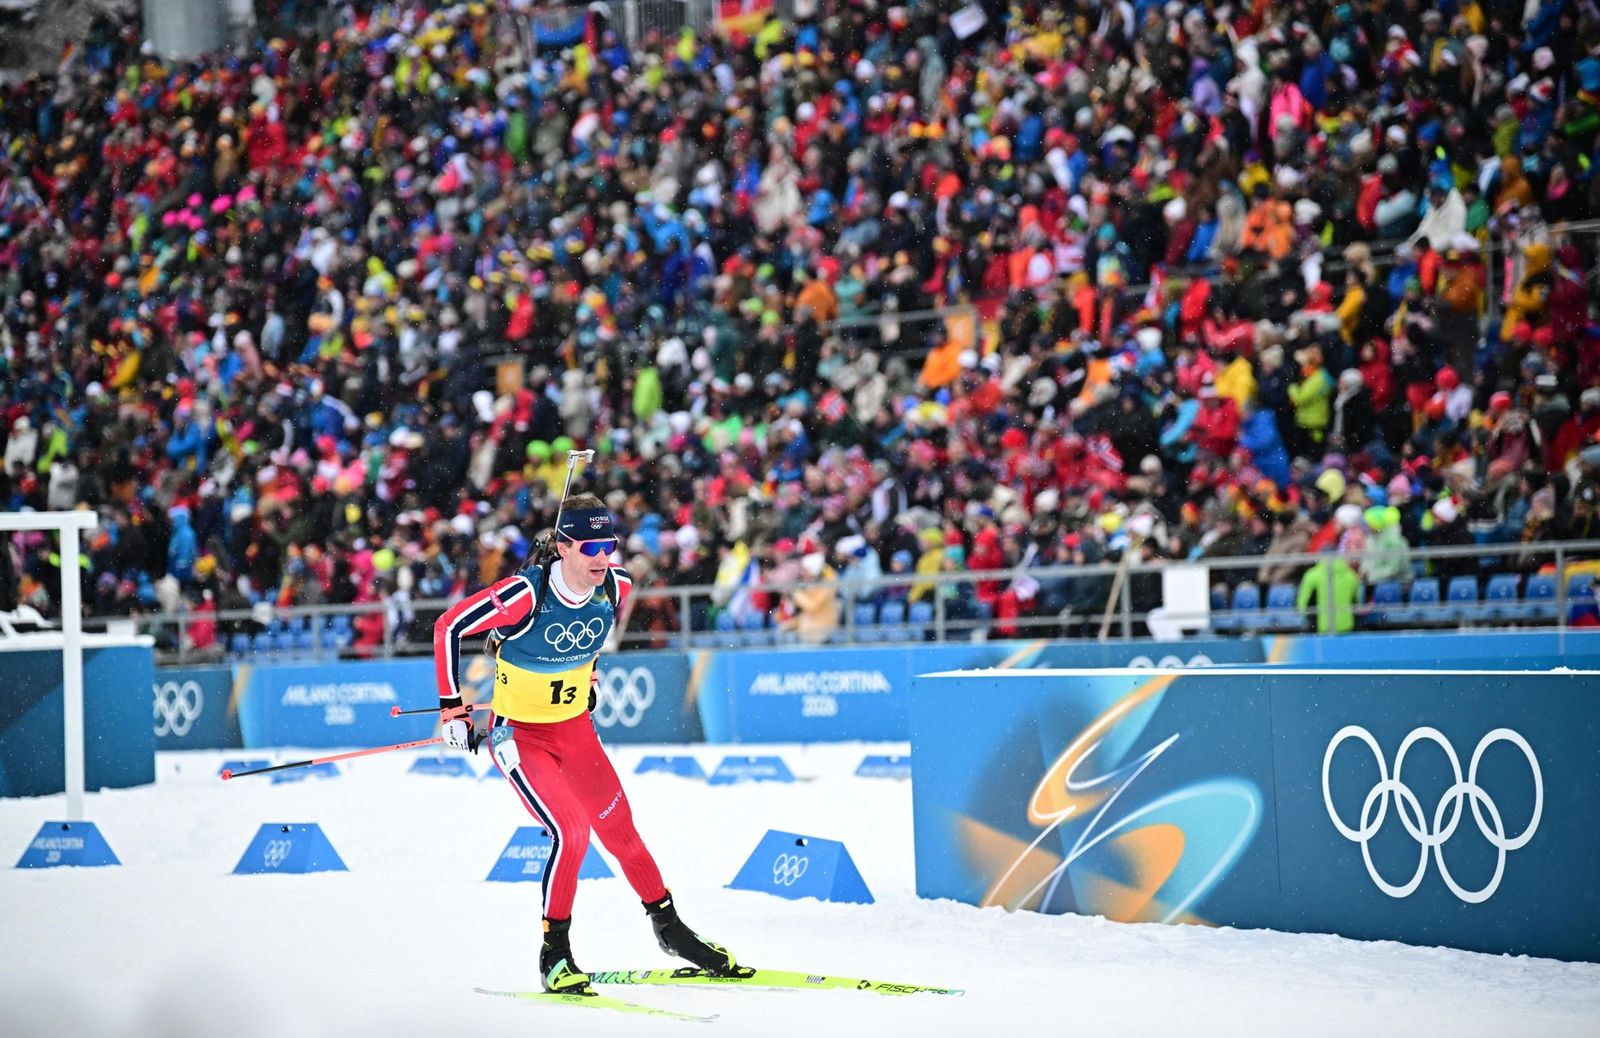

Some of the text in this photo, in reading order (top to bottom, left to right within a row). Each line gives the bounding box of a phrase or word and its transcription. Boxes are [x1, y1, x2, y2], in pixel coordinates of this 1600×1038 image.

[281, 682, 398, 706] MILANO CORTINA
[748, 670, 892, 695] MILANO CORTINA
[802, 695, 838, 717] 2026
[598, 796, 619, 819] CRAFT
